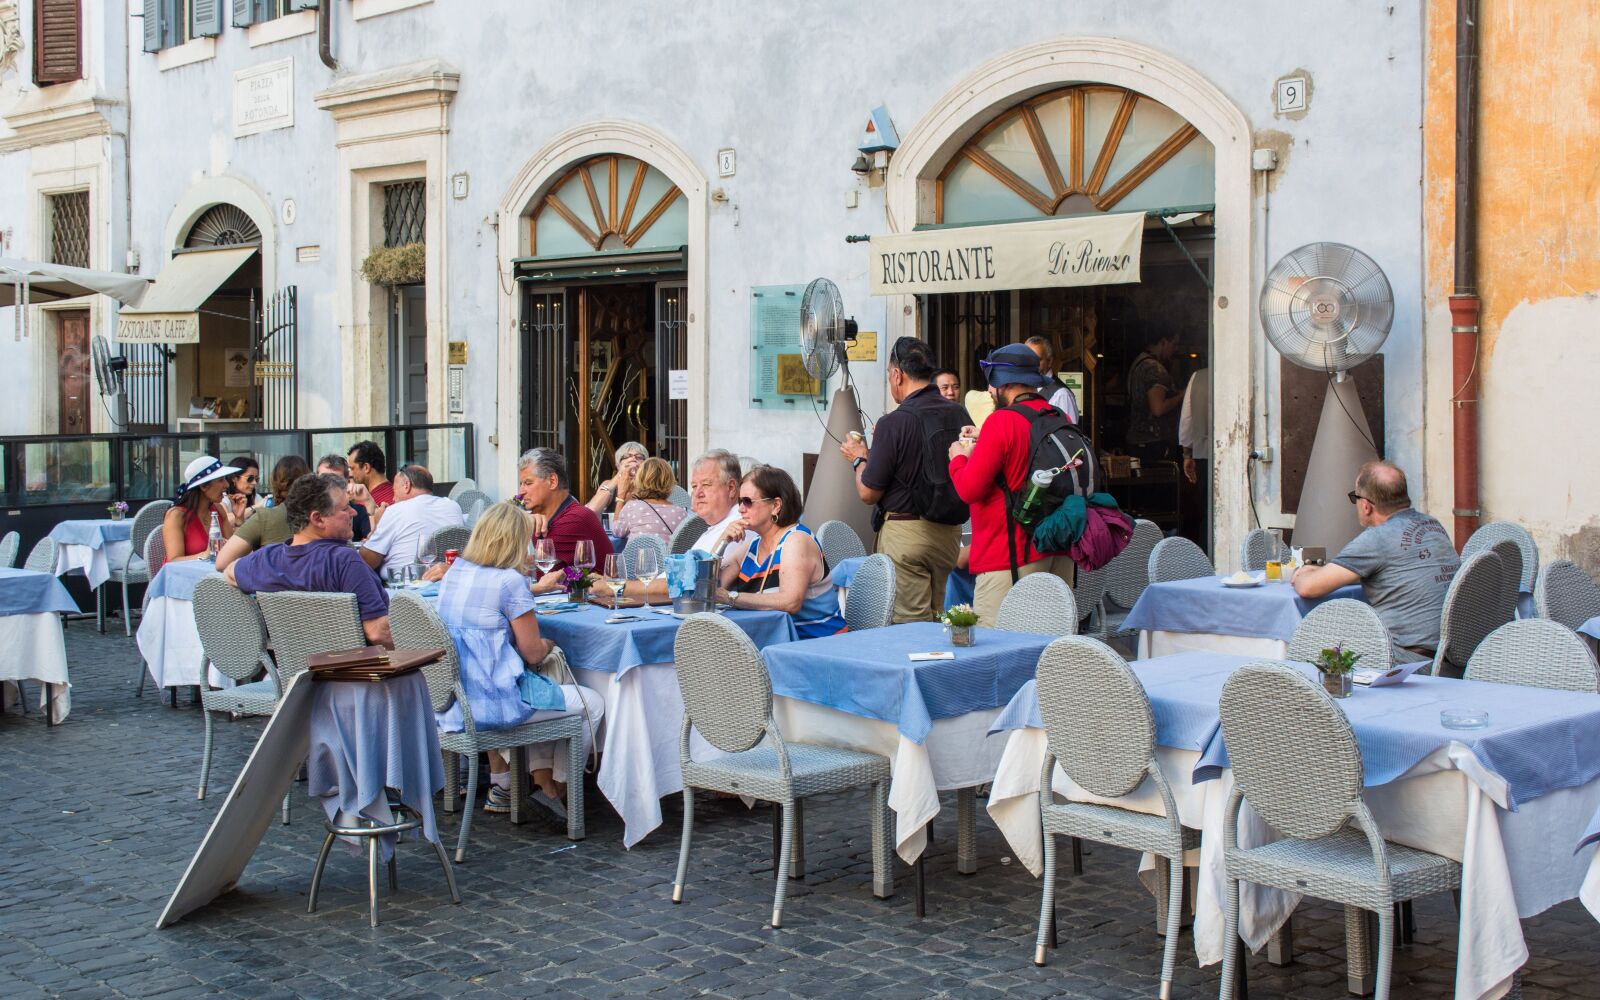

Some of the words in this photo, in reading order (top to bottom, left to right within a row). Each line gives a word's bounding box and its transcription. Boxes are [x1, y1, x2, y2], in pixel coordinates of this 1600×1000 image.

[249, 77, 274, 92] PIAZZA
[1286, 86, 1296, 105] 9
[724, 156, 730, 170] 8
[881, 245, 996, 284] RISTORANTE
[1047, 240, 1070, 275] Di
[1072, 239, 1131, 274] Rienzo
[1419, 549, 1431, 560] 63
